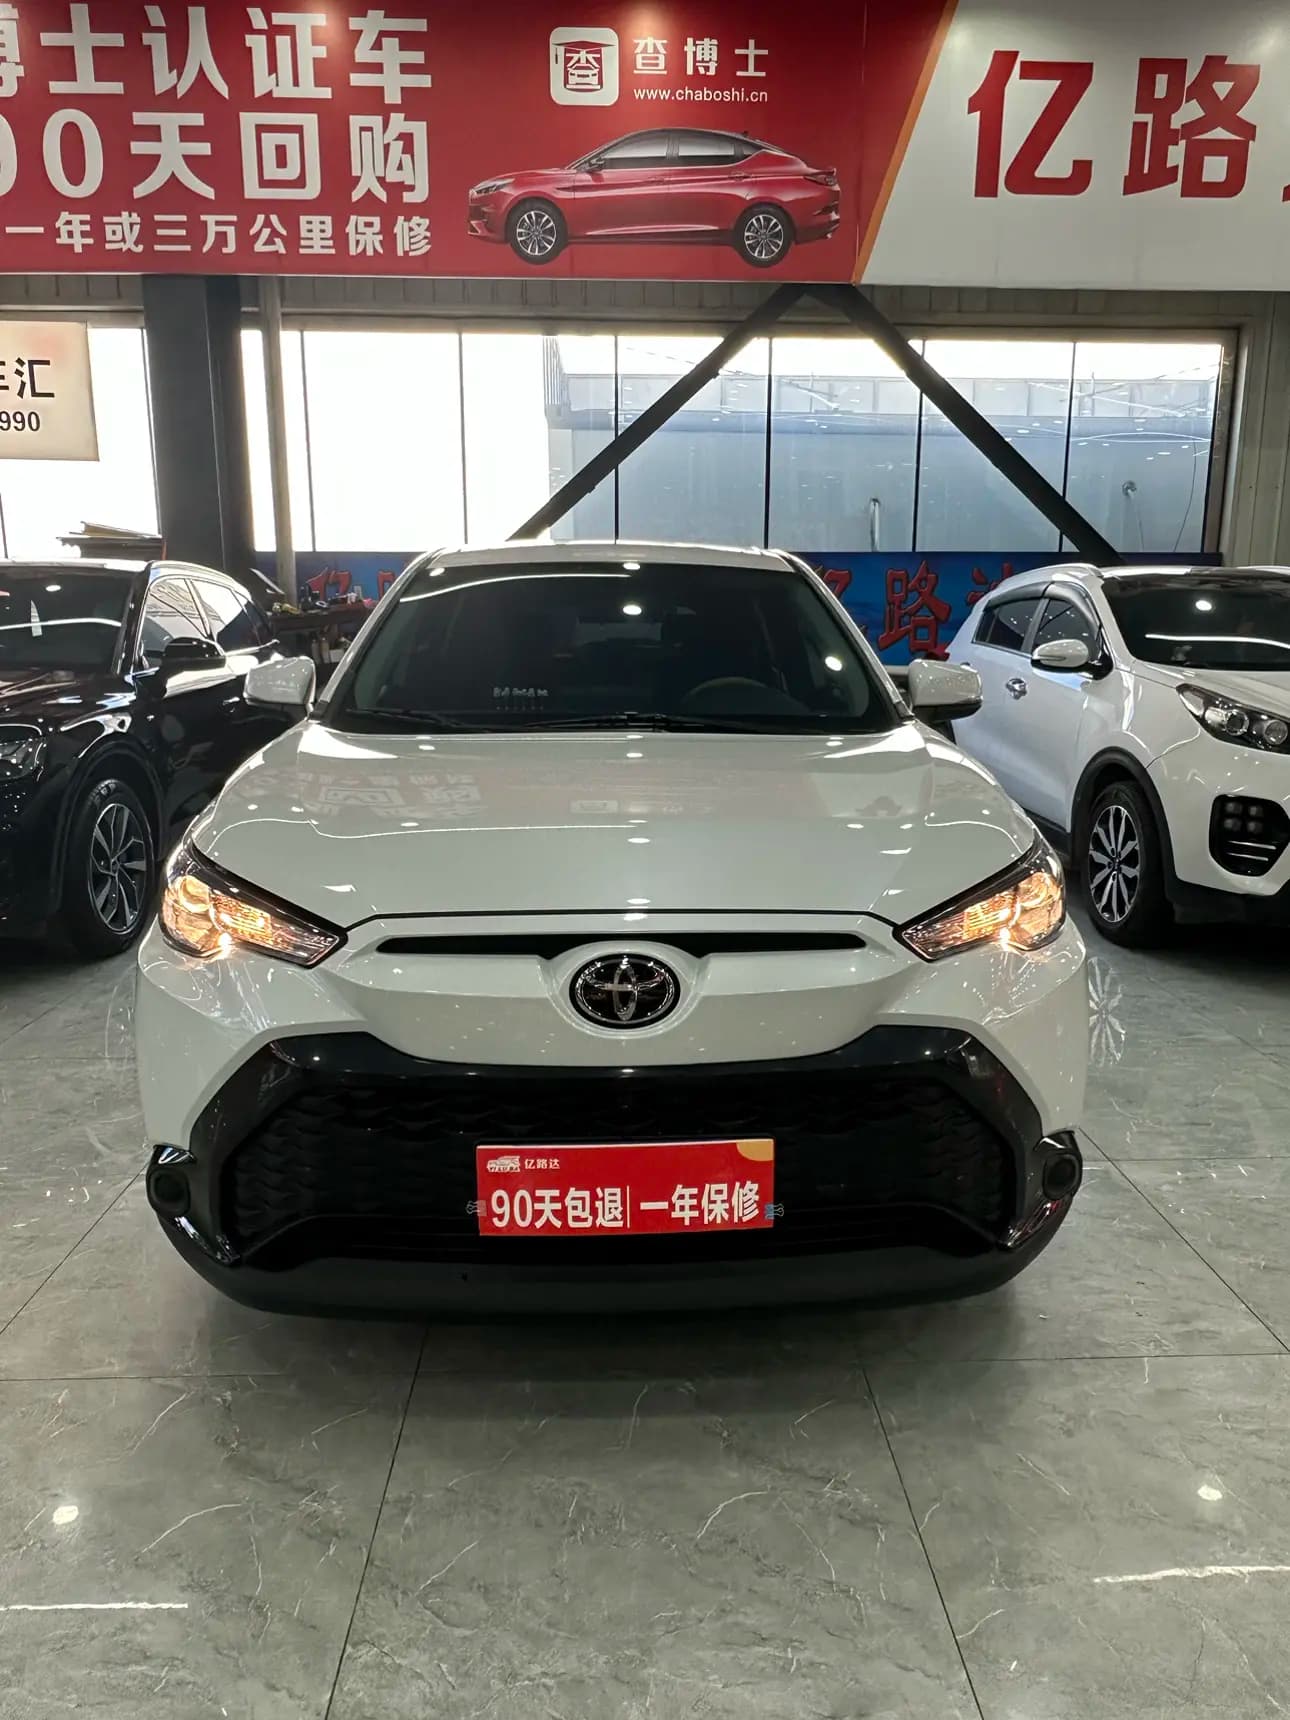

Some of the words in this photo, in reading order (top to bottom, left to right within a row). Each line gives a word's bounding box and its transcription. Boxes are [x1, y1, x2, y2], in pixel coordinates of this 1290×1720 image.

[633, 36, 769, 77] 查博士
[633, 86, 768, 103] www.chaboshi.cn
[967, 50, 1290, 203] 亿路
[4, 211, 432, 257] 一年或三万公里保修
[0, 357, 55, 399] 汇
[524, 1158, 561, 1170] 亿路达
[490, 1187, 624, 1229] 90天包退
[639, 1180, 760, 1226] 一年保修
